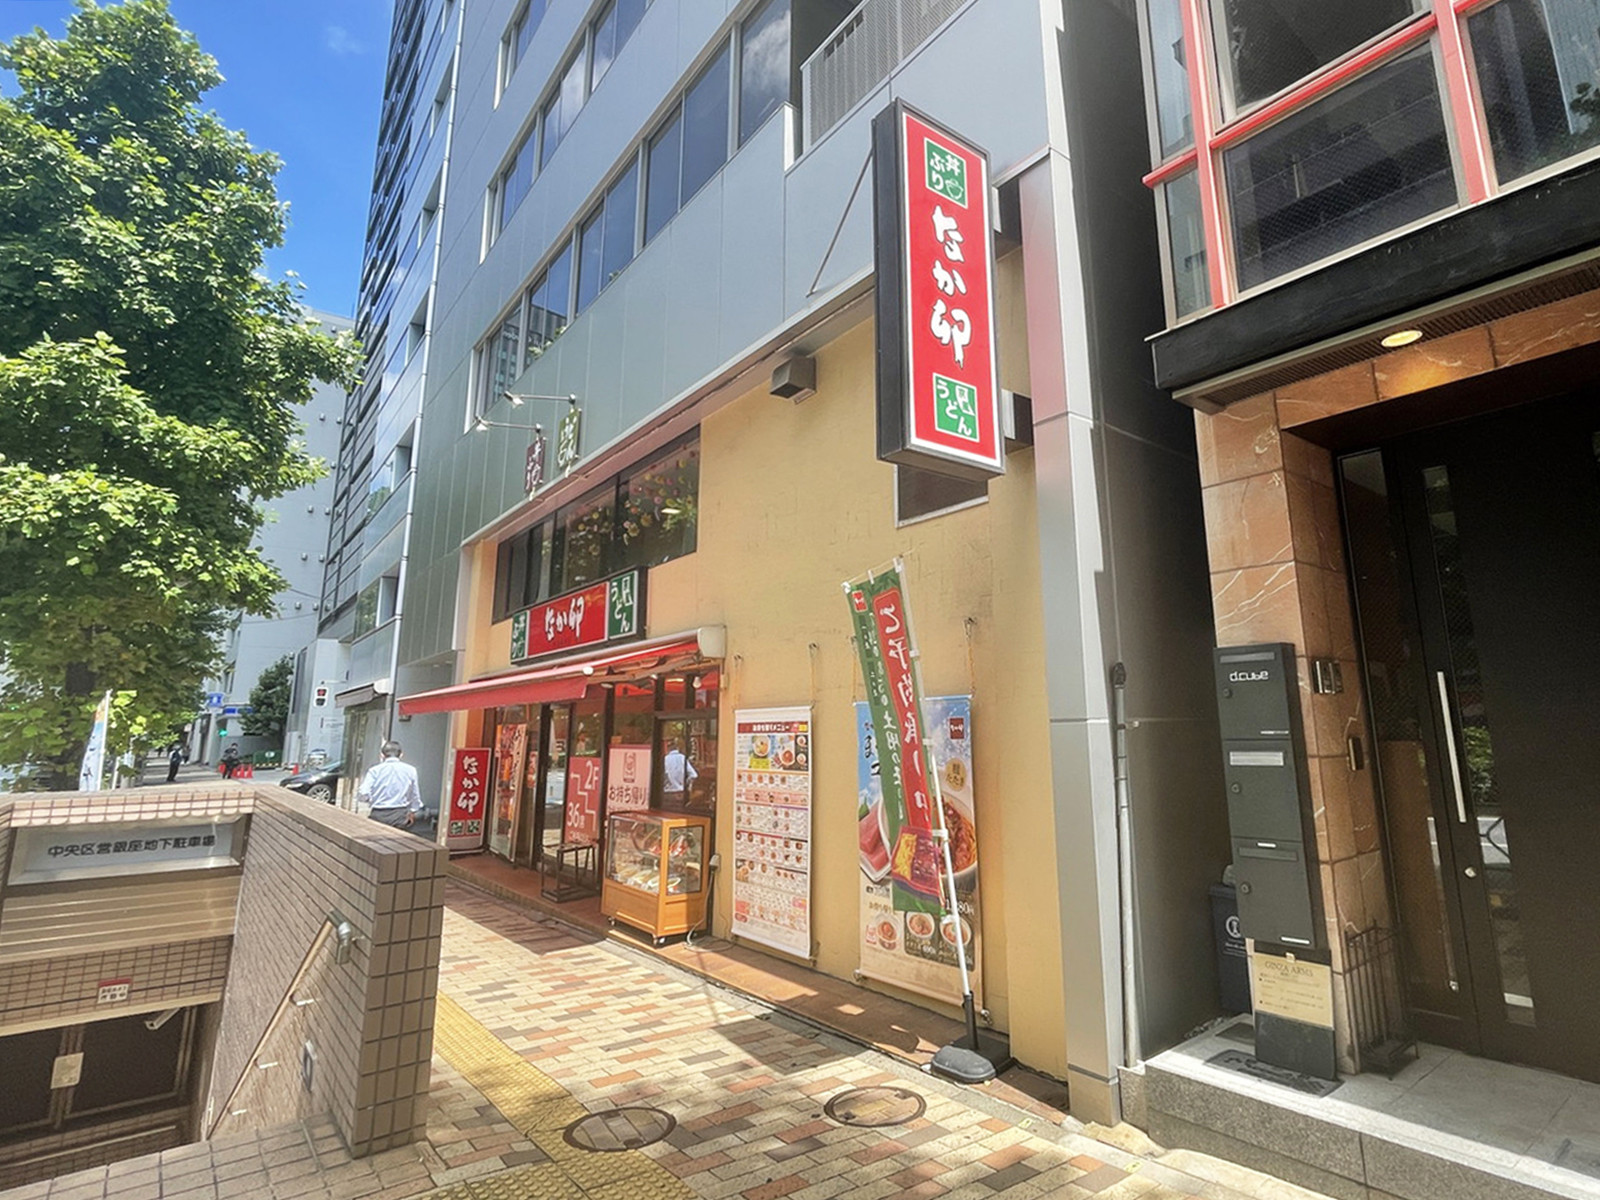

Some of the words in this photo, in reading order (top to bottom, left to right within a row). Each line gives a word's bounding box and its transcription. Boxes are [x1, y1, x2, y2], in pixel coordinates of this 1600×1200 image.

[931, 205, 972, 370] なか卯
[545, 596, 584, 641] なか卯
[457, 756, 480, 814] なか卯
[584, 760, 600, 790] 2F
[48, 835, 216, 858] 中央区営銀座地下駐車場
